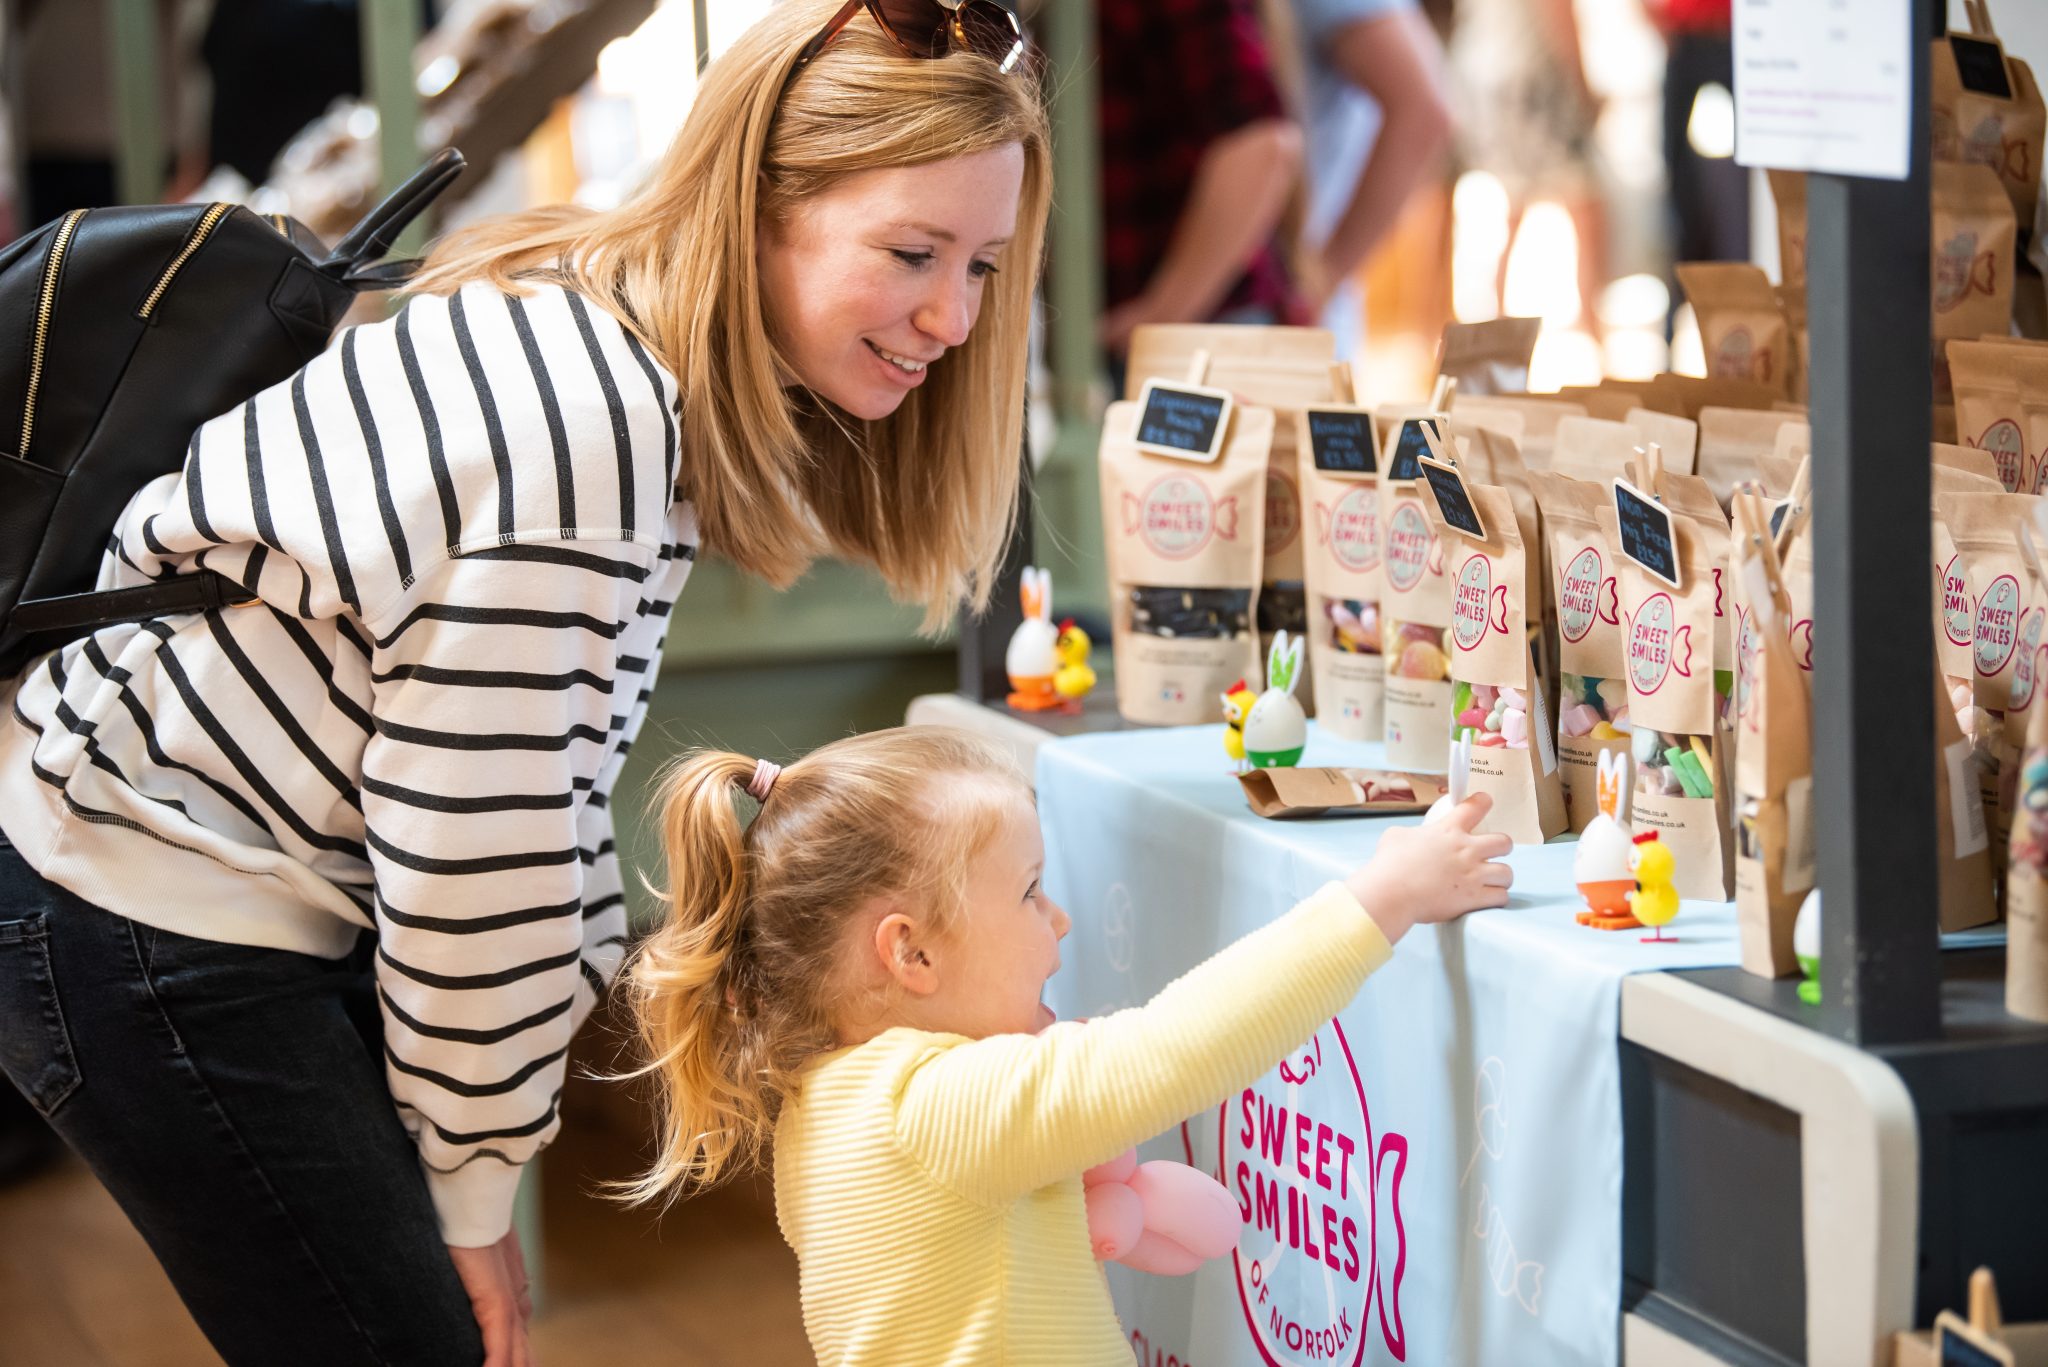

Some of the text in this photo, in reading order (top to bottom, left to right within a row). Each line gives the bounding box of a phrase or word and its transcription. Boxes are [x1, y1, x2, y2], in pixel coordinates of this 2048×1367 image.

[1339, 513, 1375, 528] SWEE
[1335, 530, 1375, 544] SMILE
[1459, 584, 1486, 604] SWEET
[1566, 577, 1596, 596] SWEET
[1455, 602, 1484, 622] SMILES
[1563, 594, 1592, 614] SMILES
[1945, 594, 1968, 613] SMIL
[1980, 607, 2012, 626] SWEET
[1635, 624, 1668, 645] SWEET
[1976, 624, 2010, 645] SMILES
[1632, 642, 1665, 664] SMILES
[1240, 1087, 1355, 1200] SWEET
[1237, 1160, 1360, 1282] SMILES
[1251, 1259, 1353, 1360] OF NORFOLK
